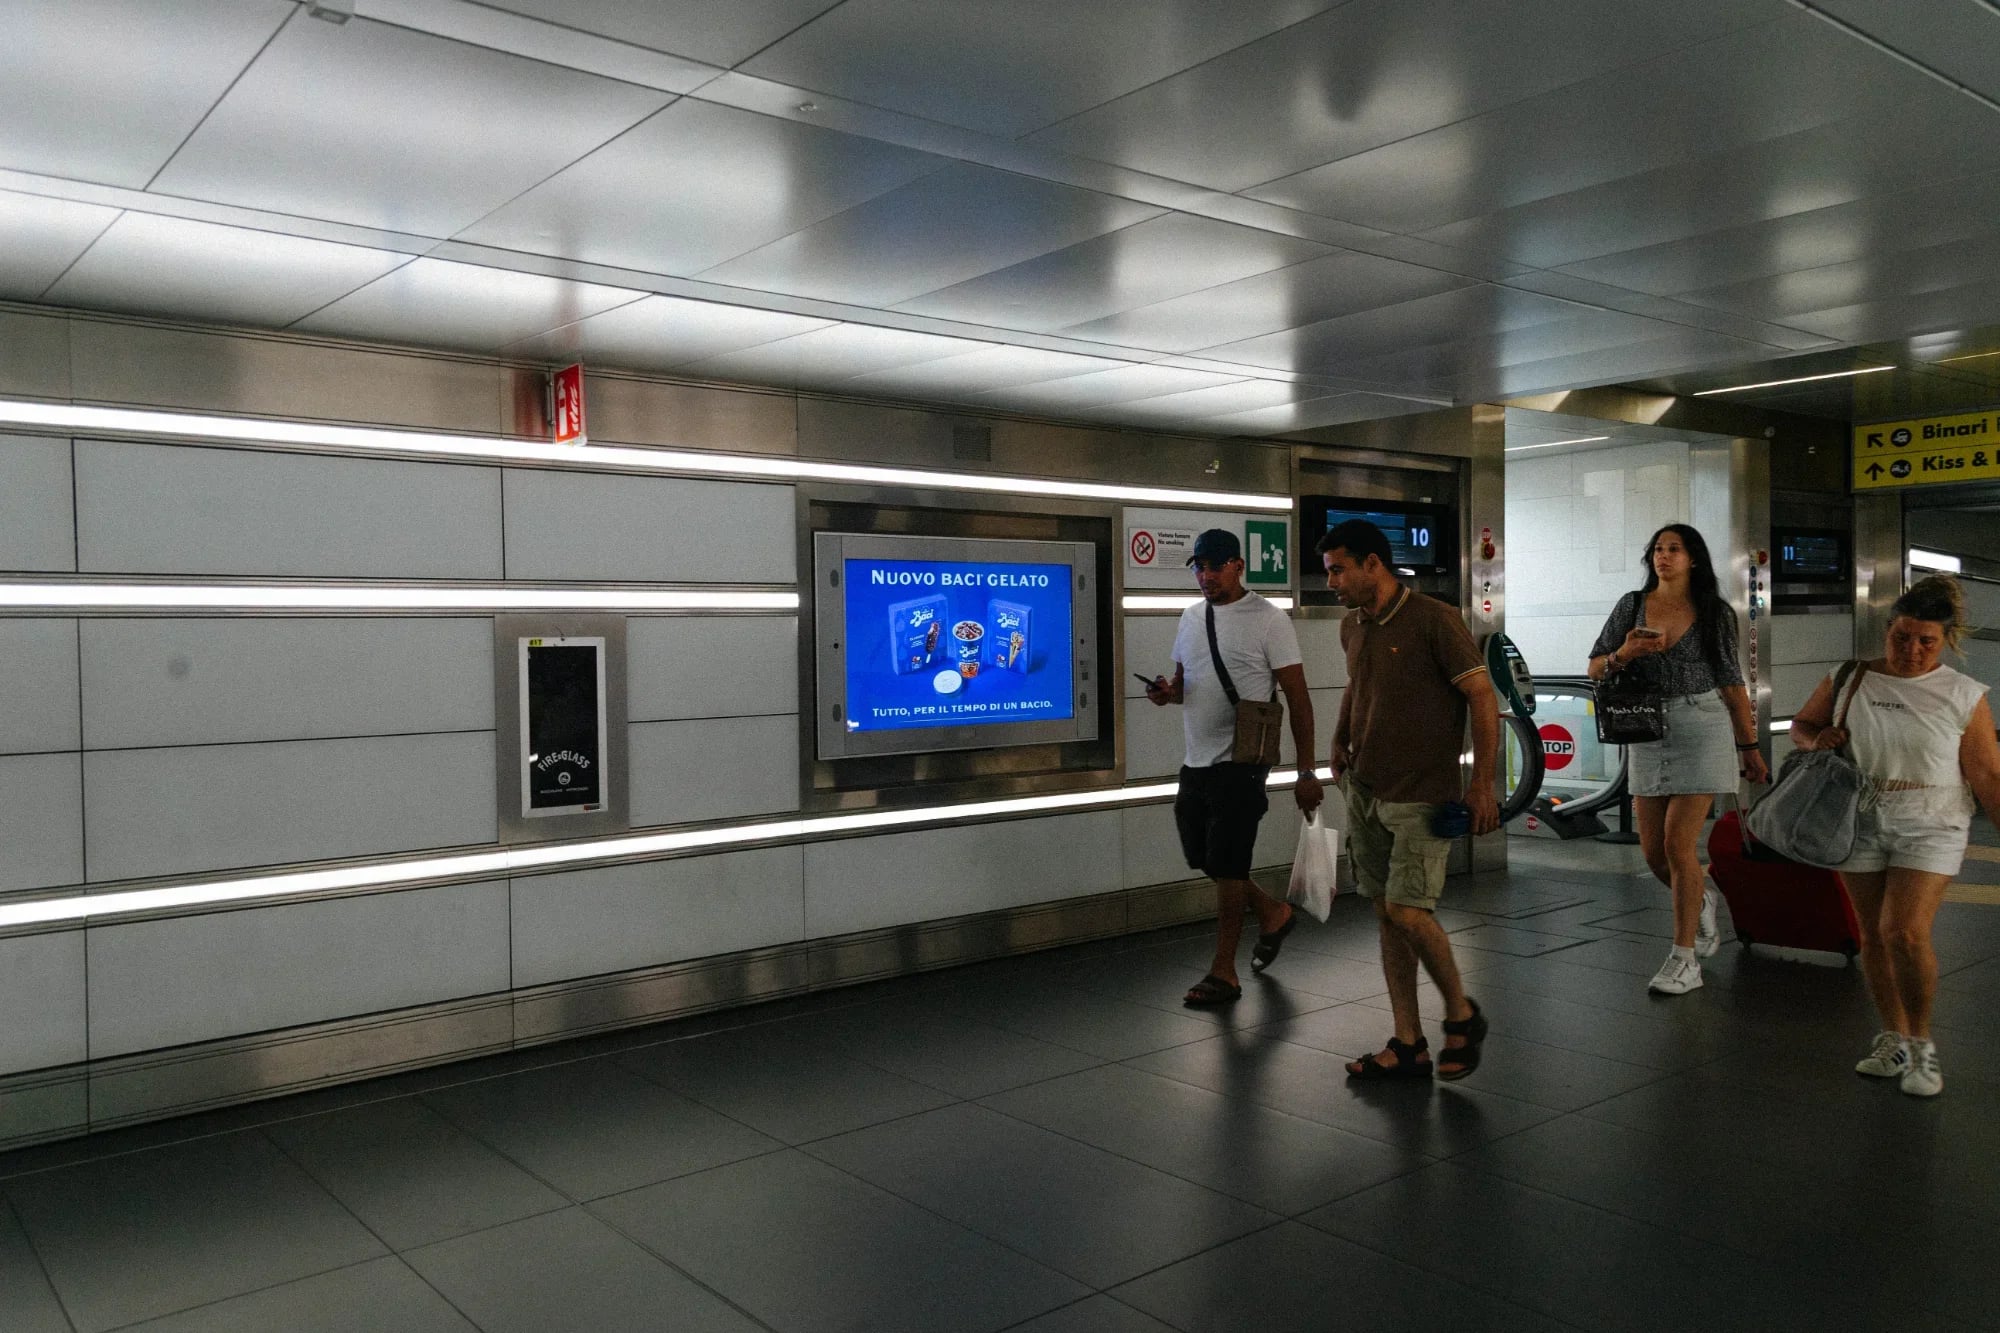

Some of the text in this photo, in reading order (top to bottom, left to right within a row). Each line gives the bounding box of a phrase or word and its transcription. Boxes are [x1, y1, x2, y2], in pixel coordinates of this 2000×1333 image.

[1923, 418, 1988, 440] Binari
[1922, 455, 1965, 472] Kiss
[1972, 451, 1989, 467] &
[1411, 527, 1429, 547] 10
[1783, 545, 1794, 561] 11
[987, 573, 1049, 588] GELATO
[872, 700, 1053, 717] TUTTO, PER IL TEMPO DI UN BACIO.
[1543, 741, 1572, 753] TOP
